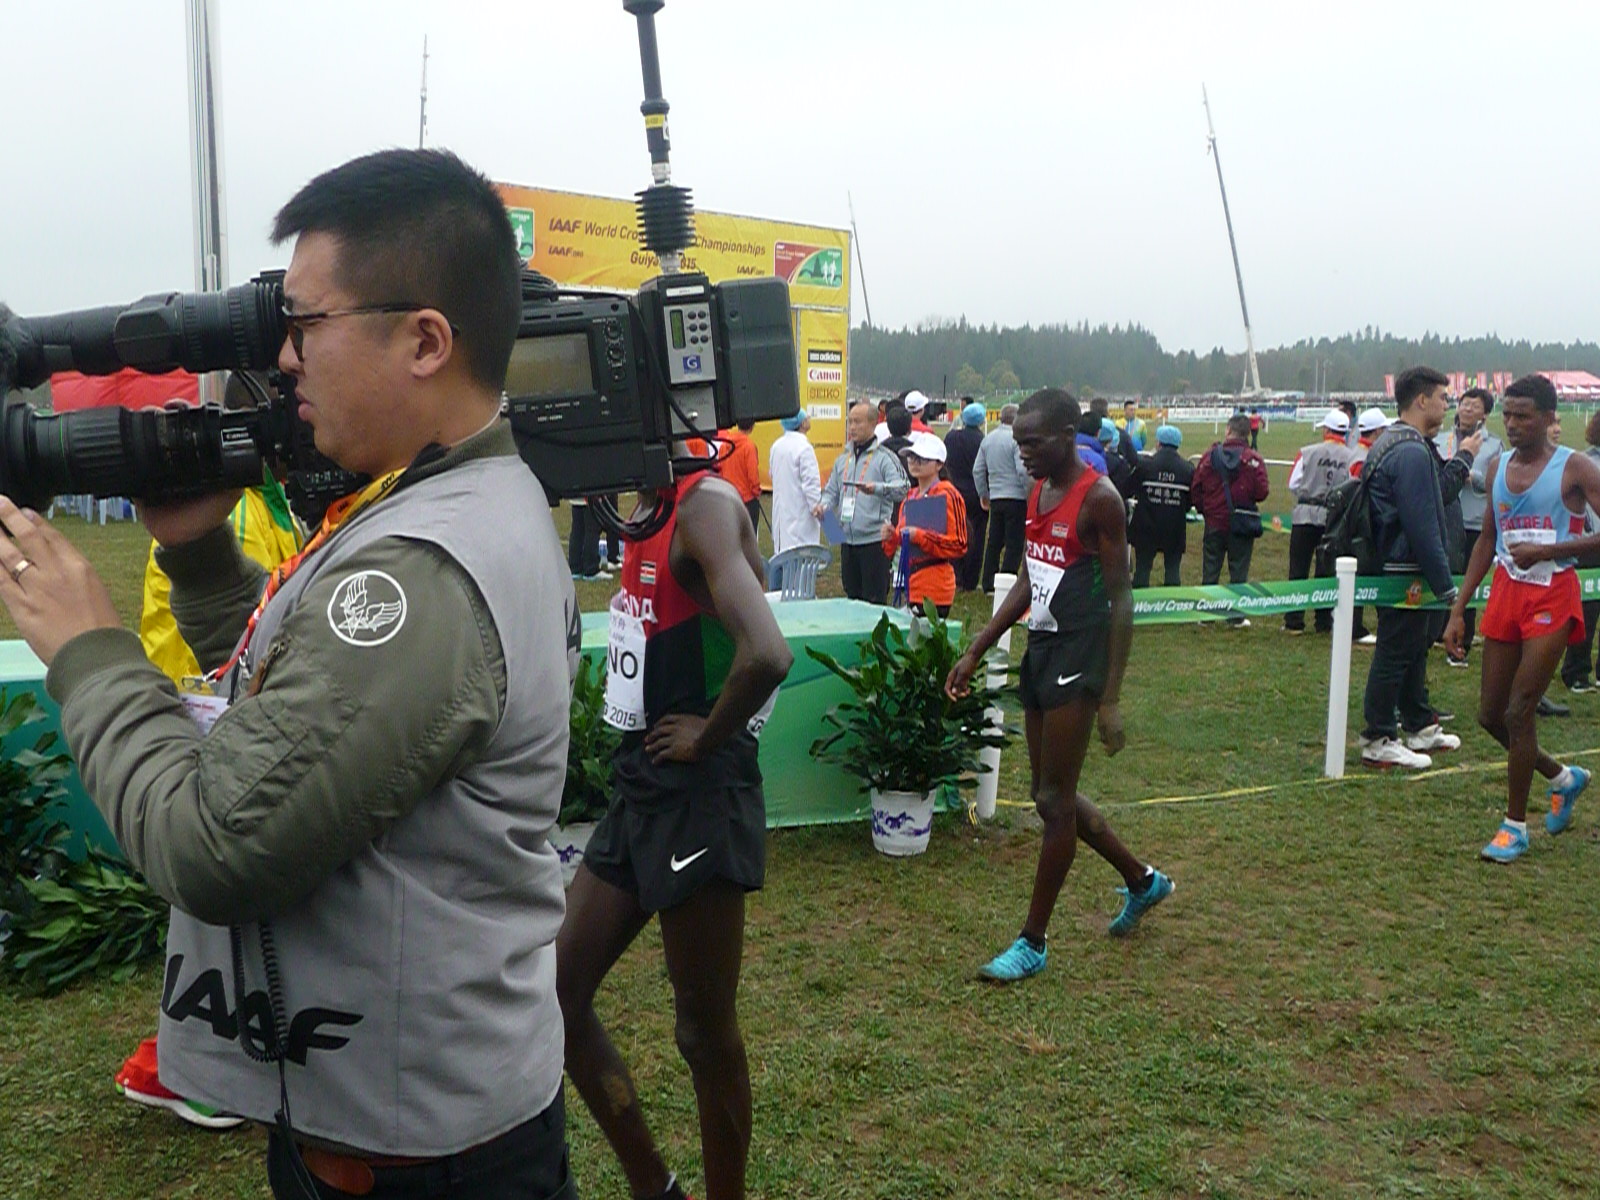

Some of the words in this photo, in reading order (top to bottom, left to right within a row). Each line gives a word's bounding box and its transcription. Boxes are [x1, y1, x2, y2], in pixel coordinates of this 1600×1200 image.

[549, 217, 582, 234] IAAF
[585, 221, 618, 239] World
[619, 226, 646, 242] Cro
[694, 234, 766, 258] Championships
[630, 251, 660, 268] Guiya
[680, 257, 697, 270] 015
[809, 369, 841, 381] Canon
[810, 387, 840, 399] SEIKO
[1026, 540, 1066, 563] ENYA
[1134, 601, 1165, 613] World
[1165, 600, 1194, 611] Cross
[1196, 598, 1234, 611] Country
[1237, 592, 1309, 608] Championships
[1311, 589, 1339, 603] GUIYA
[1355, 588, 1379, 600] 2015
[610, 706, 637, 728] 2015
[161, 953, 365, 1067] IAAF
